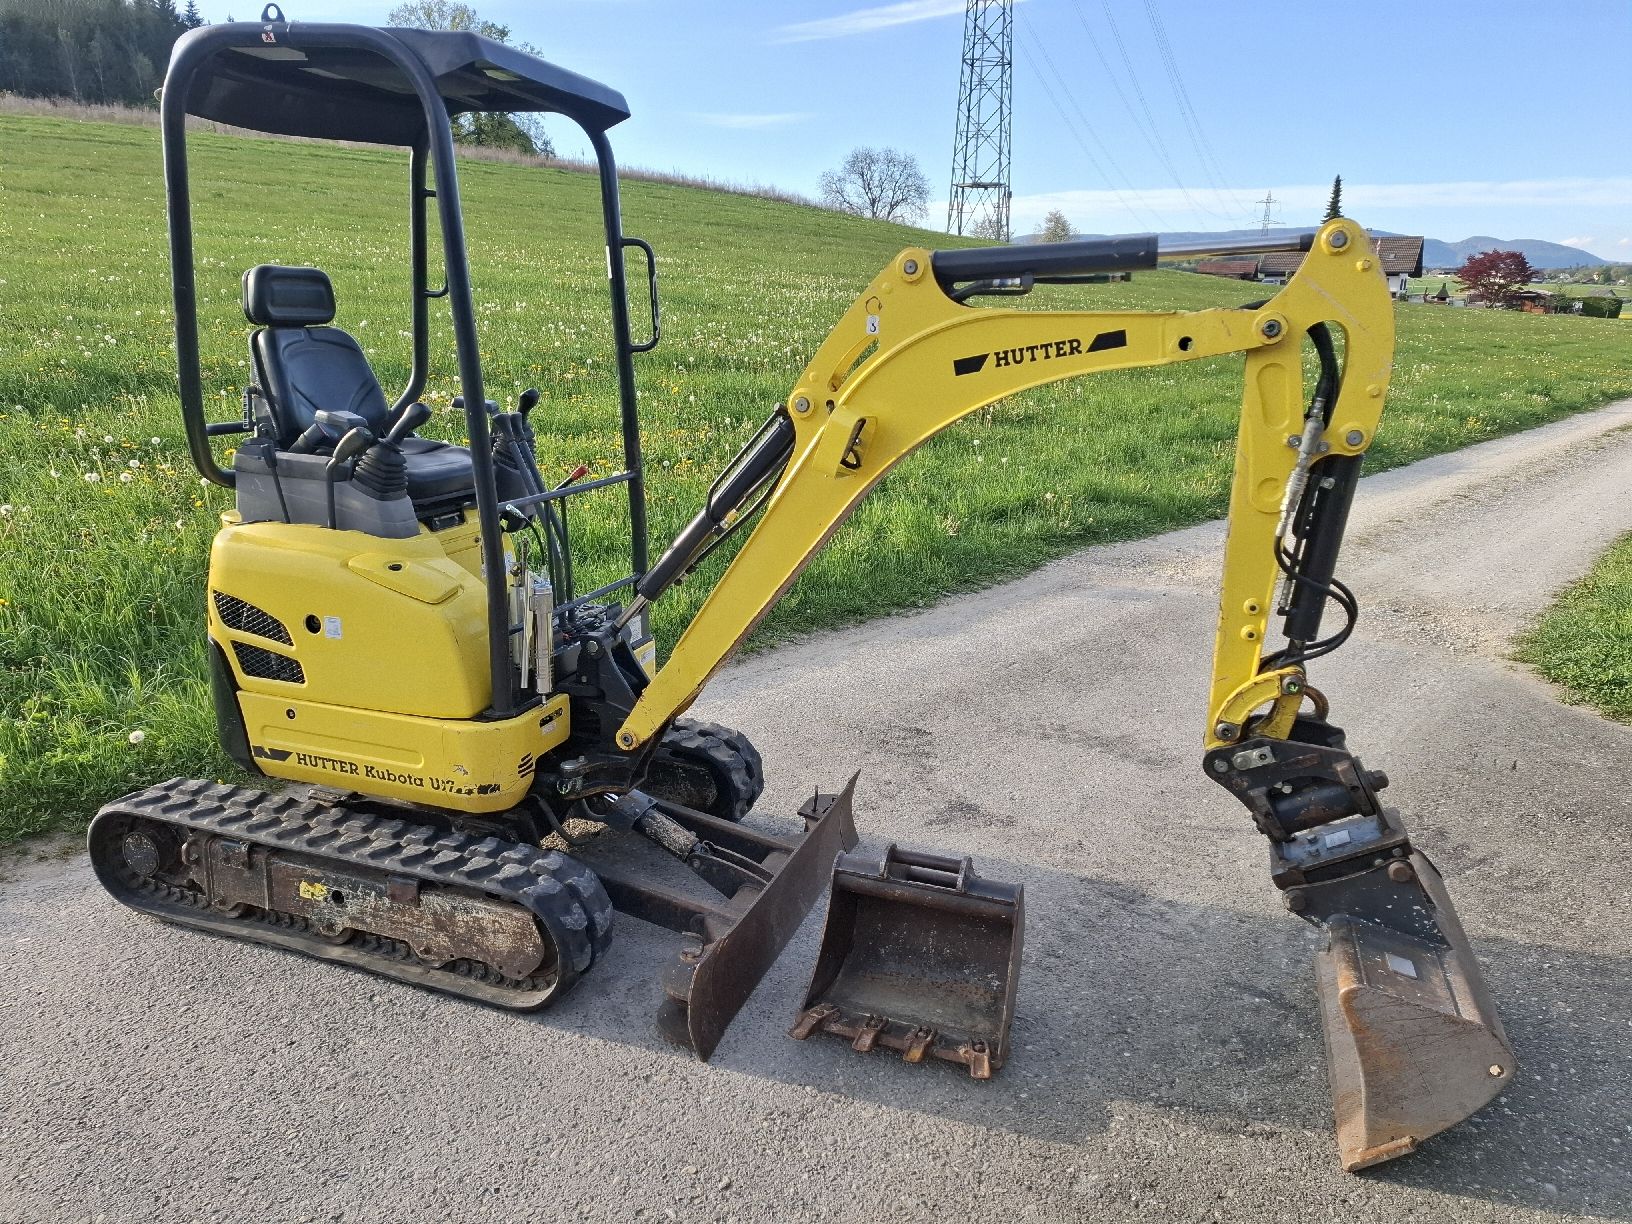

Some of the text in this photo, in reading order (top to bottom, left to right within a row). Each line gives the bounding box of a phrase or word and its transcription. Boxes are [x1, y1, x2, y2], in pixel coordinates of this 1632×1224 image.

[993, 338, 1082, 368] HUTTER
[296, 752, 360, 776] HUTTER
[363, 765, 425, 788] Kubota
